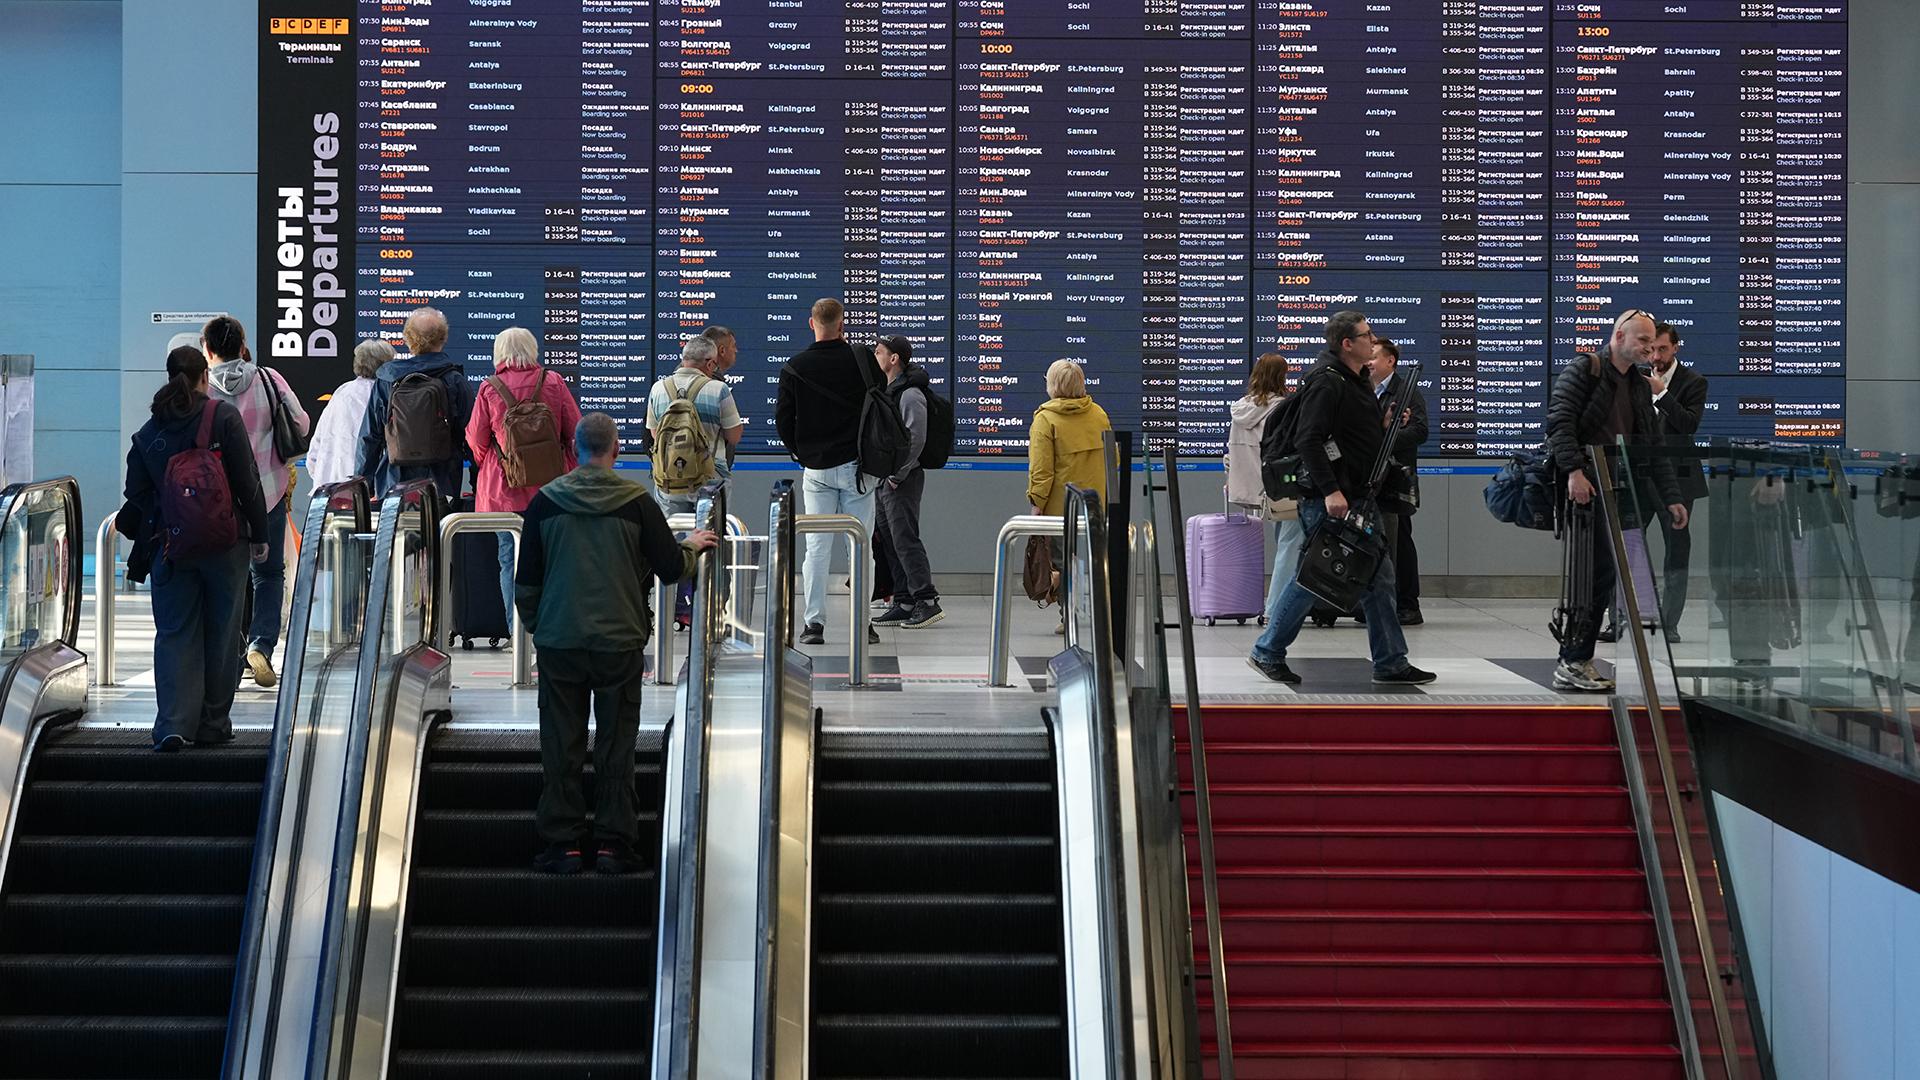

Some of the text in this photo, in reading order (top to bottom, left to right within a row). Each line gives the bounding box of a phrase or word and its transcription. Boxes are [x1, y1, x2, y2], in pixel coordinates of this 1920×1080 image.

[272, 20, 342, 28] B C D E F
[382, 18, 429, 28] Мин.Воды
[470, 20, 537, 28] Mineralnye Vody
[682, 19, 721, 28] Грозный
[769, 22, 797, 30] Grozny
[1578, 27, 1610, 37] 13:00
[278, 42, 342, 52] Терминалы
[681, 40, 730, 51] Волгоград
[981, 44, 1013, 54] 10:00
[286, 55, 334, 64] Terminals
[980, 63, 1060, 74] Санкт-Петербург
[1279, 65, 1324, 75] Салехард
[1577, 66, 1616, 77] Бахрейн
[381, 80, 446, 91] Екатеринбург
[681, 84, 714, 93] 09:00
[381, 101, 437, 109] Касабланка
[681, 103, 743, 114] Калининград
[1278, 127, 1297, 138] Уфа
[980, 147, 1042, 157] Новосибирск
[1279, 148, 1316, 159] Иркутск
[980, 168, 1031, 178] Краснодар
[1279, 190, 1333, 199] Красноярск
[1577, 192, 1608, 202] Пермь
[1577, 213, 1629, 223] Геленджик
[307, 112, 346, 357] Departures
[380, 249, 413, 258] 08:00
[1278, 252, 1323, 263] Оренбург
[272, 187, 304, 357] Вылеты
[768, 272, 816, 280] Chelyabinsk
[1280, 275, 1310, 285] 12:00
[380, 289, 461, 300] Санкт-Петербург
[979, 292, 1052, 301] Новый Уренгой
[1090, 295, 1124, 303] Urengoy
[1576, 296, 1611, 306] Самара
[979, 334, 1002, 345] Орск
[1576, 338, 1603, 348] Брест
[979, 355, 1002, 366] Доха
[978, 418, 1022, 428] Абу-Даби
